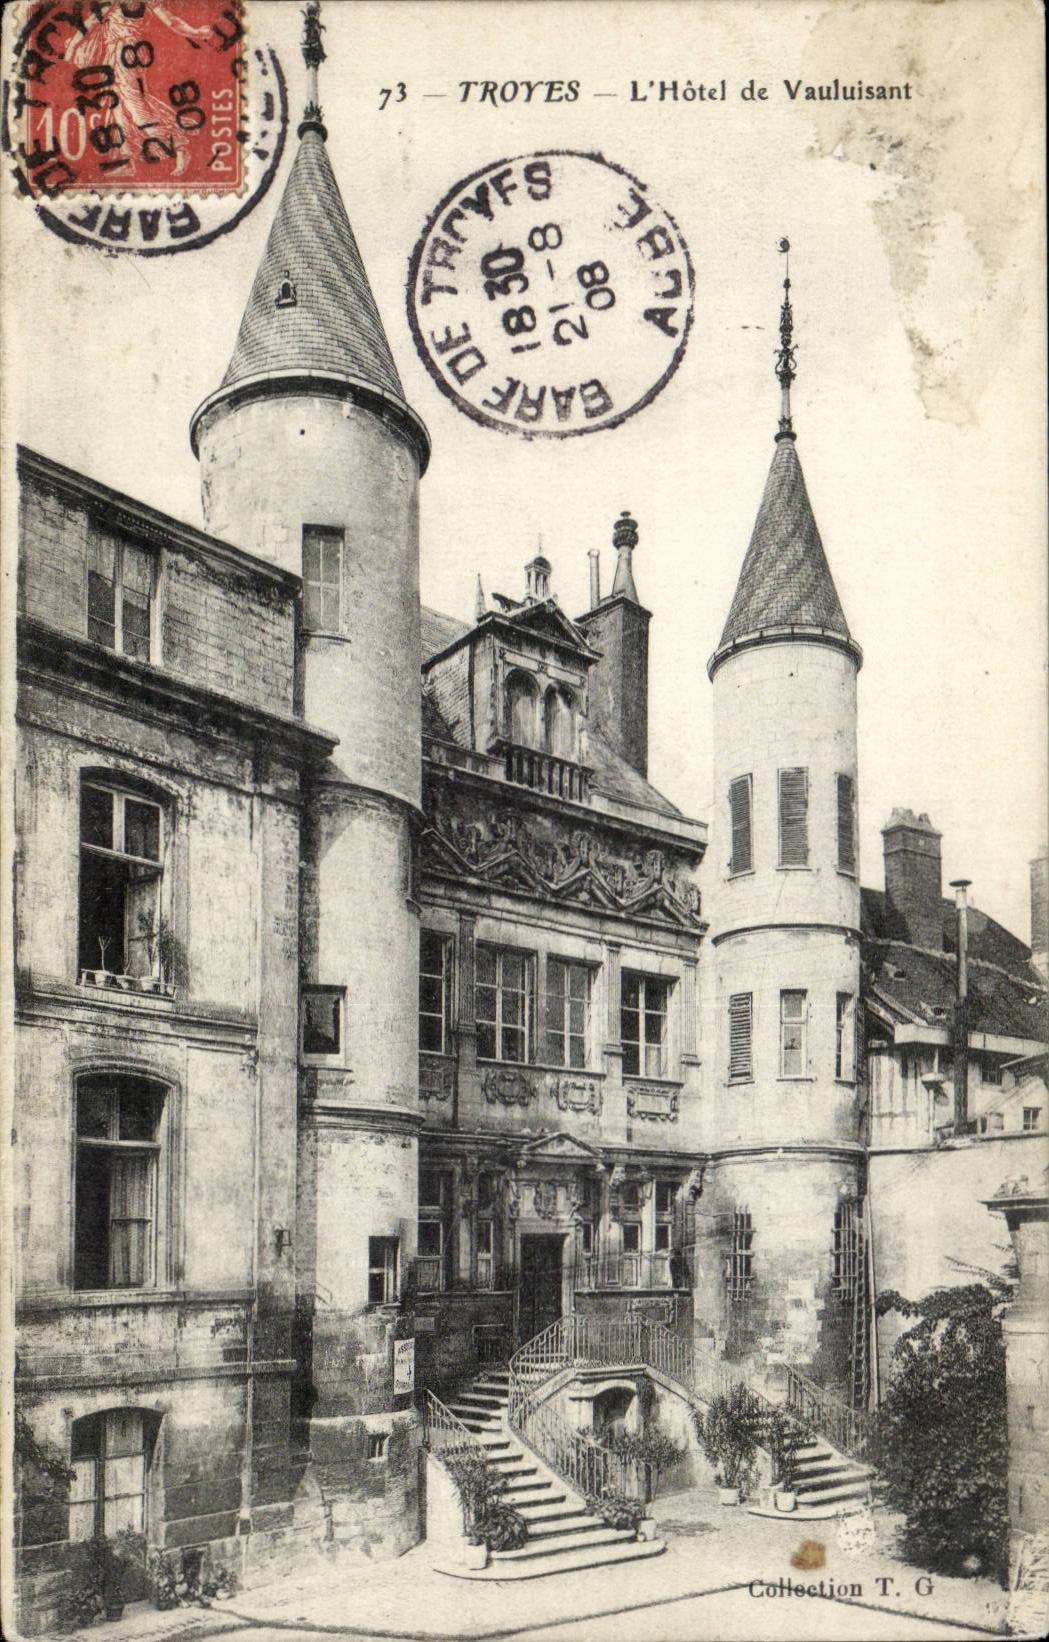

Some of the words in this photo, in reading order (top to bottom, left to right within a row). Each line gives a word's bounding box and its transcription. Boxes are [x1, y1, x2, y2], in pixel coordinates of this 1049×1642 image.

[211, 88, 233, 172] POSTES
[577, 260, 616, 310] 08
[430, 321, 488, 387] DE
